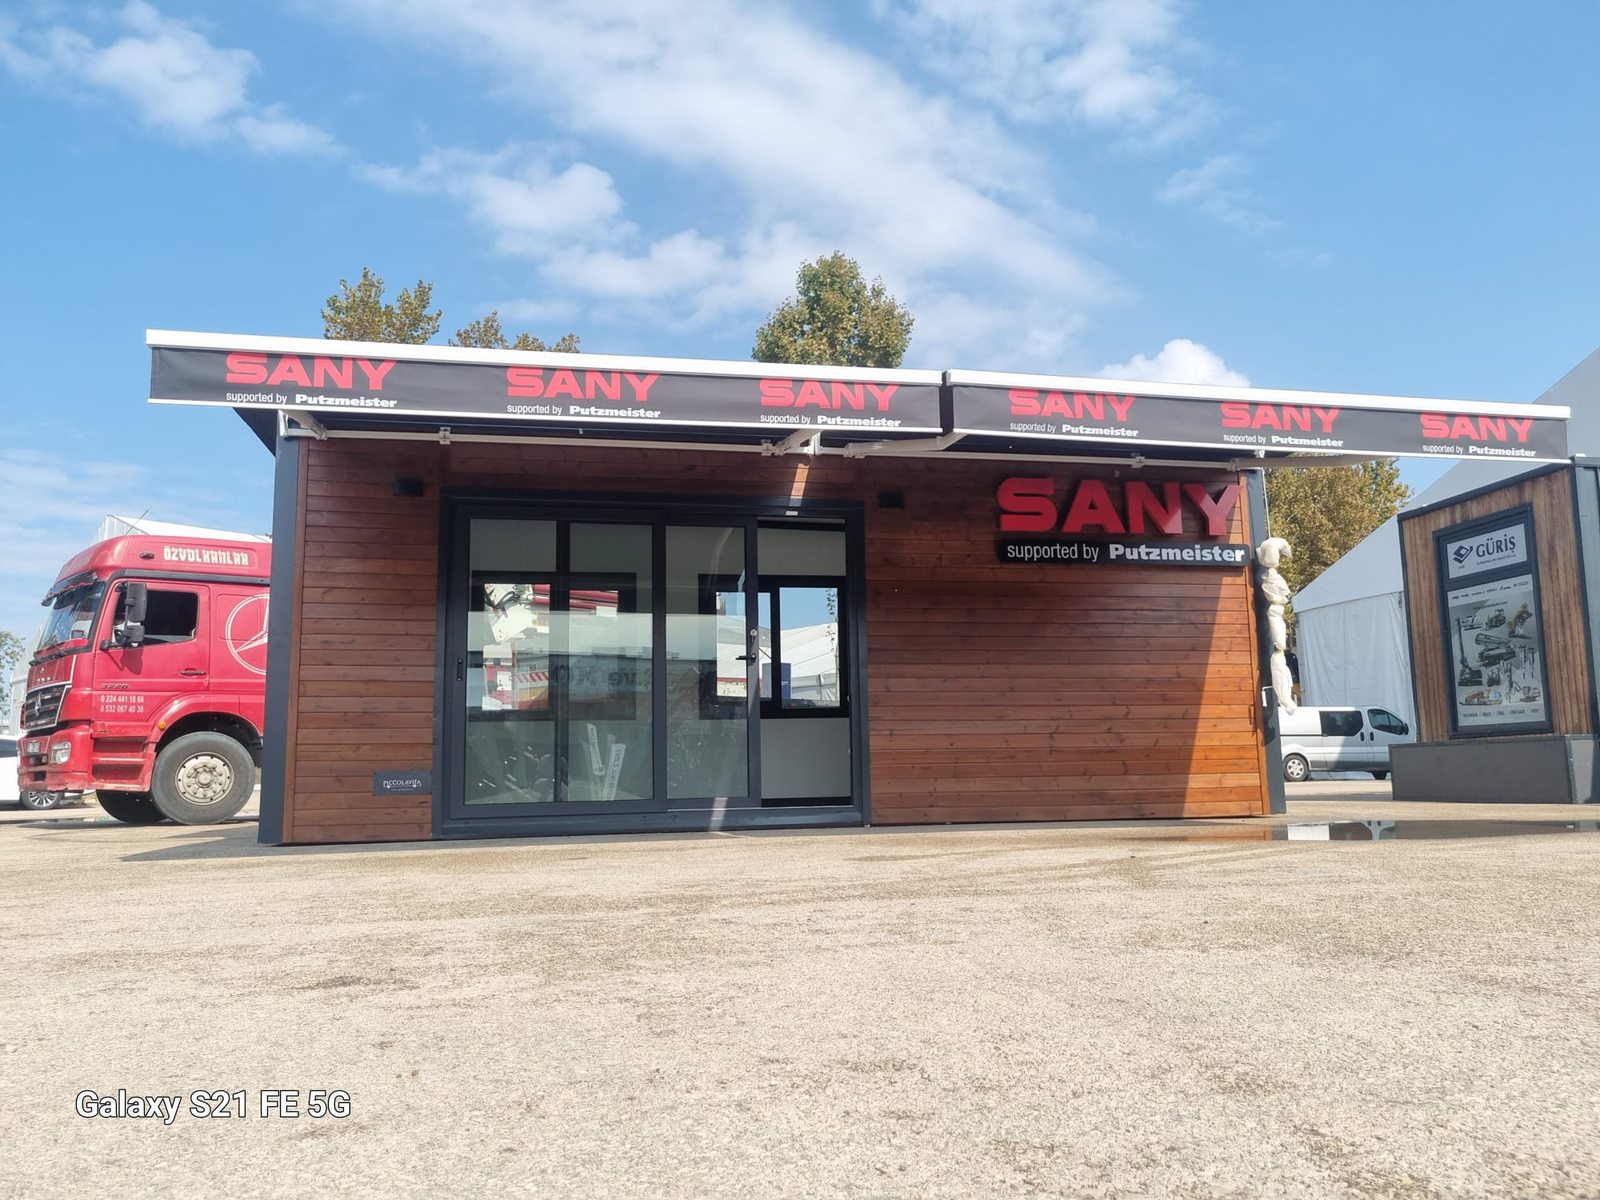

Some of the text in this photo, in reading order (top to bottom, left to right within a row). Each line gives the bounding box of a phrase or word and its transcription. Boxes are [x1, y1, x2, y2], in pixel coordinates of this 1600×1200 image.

[226, 352, 396, 391] SANY
[506, 366, 660, 401] SANY
[226, 393, 398, 408] supported by Putzmeister
[759, 379, 900, 411] SANY
[1008, 388, 1136, 421] SANY
[507, 404, 661, 418] supported by Putzmeister
[760, 414, 901, 427] supported by Putzmeister
[1221, 401, 1340, 433] SANY
[1010, 422, 1139, 437] supported by Putzmeister
[1420, 413, 1533, 442] SANY
[1223, 434, 1343, 447] supported by Putzmeister
[1422, 444, 1536, 457] supported by Putzmeister
[996, 477, 1242, 536] SANY
[1007, 543, 1245, 562] supported by Putzmeister
[1476, 533, 1516, 558] GÜRİŞ
[106, 695, 117, 703] 224
